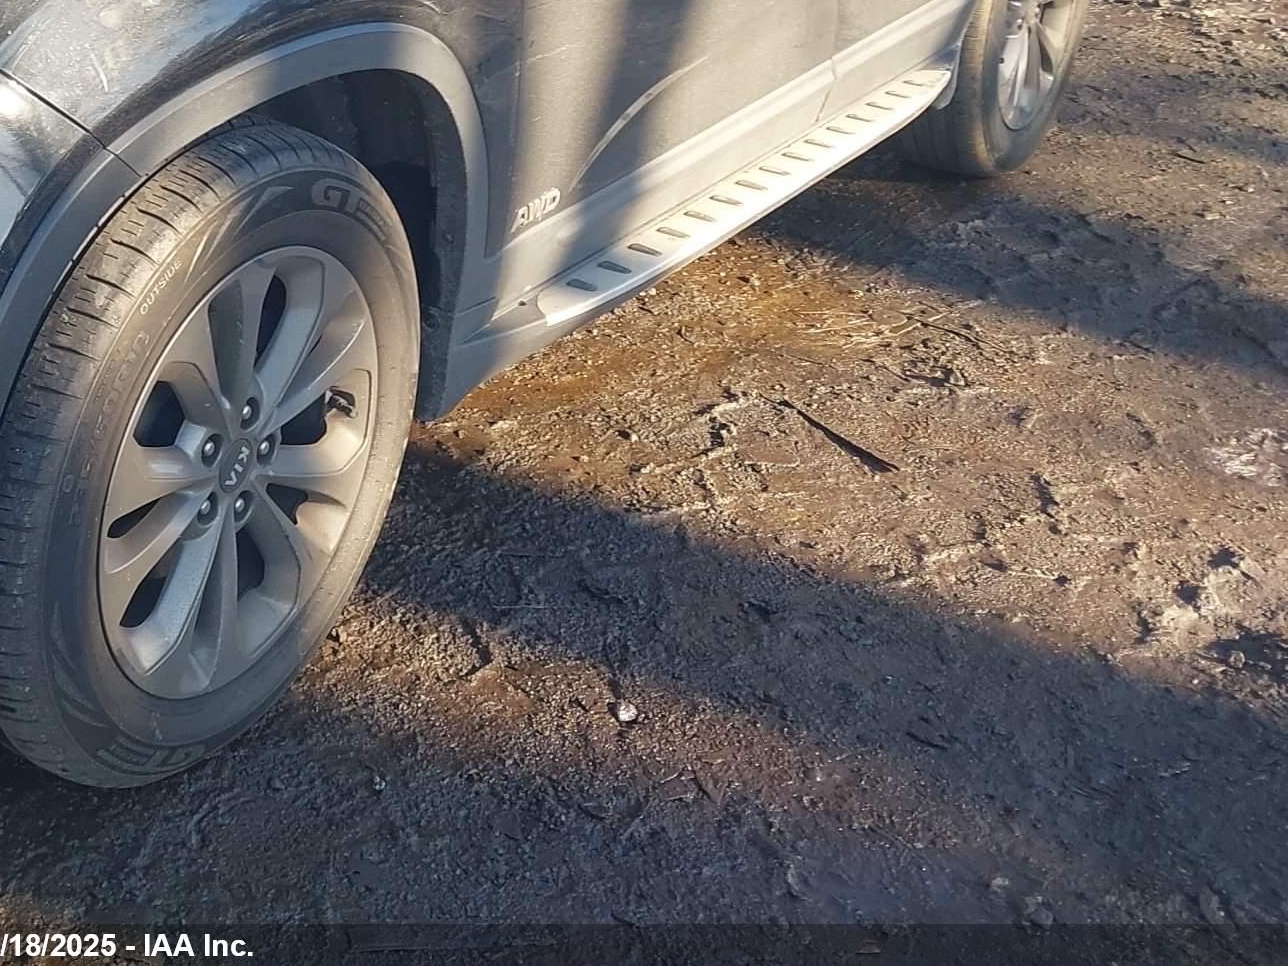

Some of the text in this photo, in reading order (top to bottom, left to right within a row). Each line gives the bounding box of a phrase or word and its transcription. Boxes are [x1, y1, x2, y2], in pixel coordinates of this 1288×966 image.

[510, 187, 561, 233] AWD
[140, 257, 183, 315] OUTSIDE
[224, 446, 250, 486] KIA
